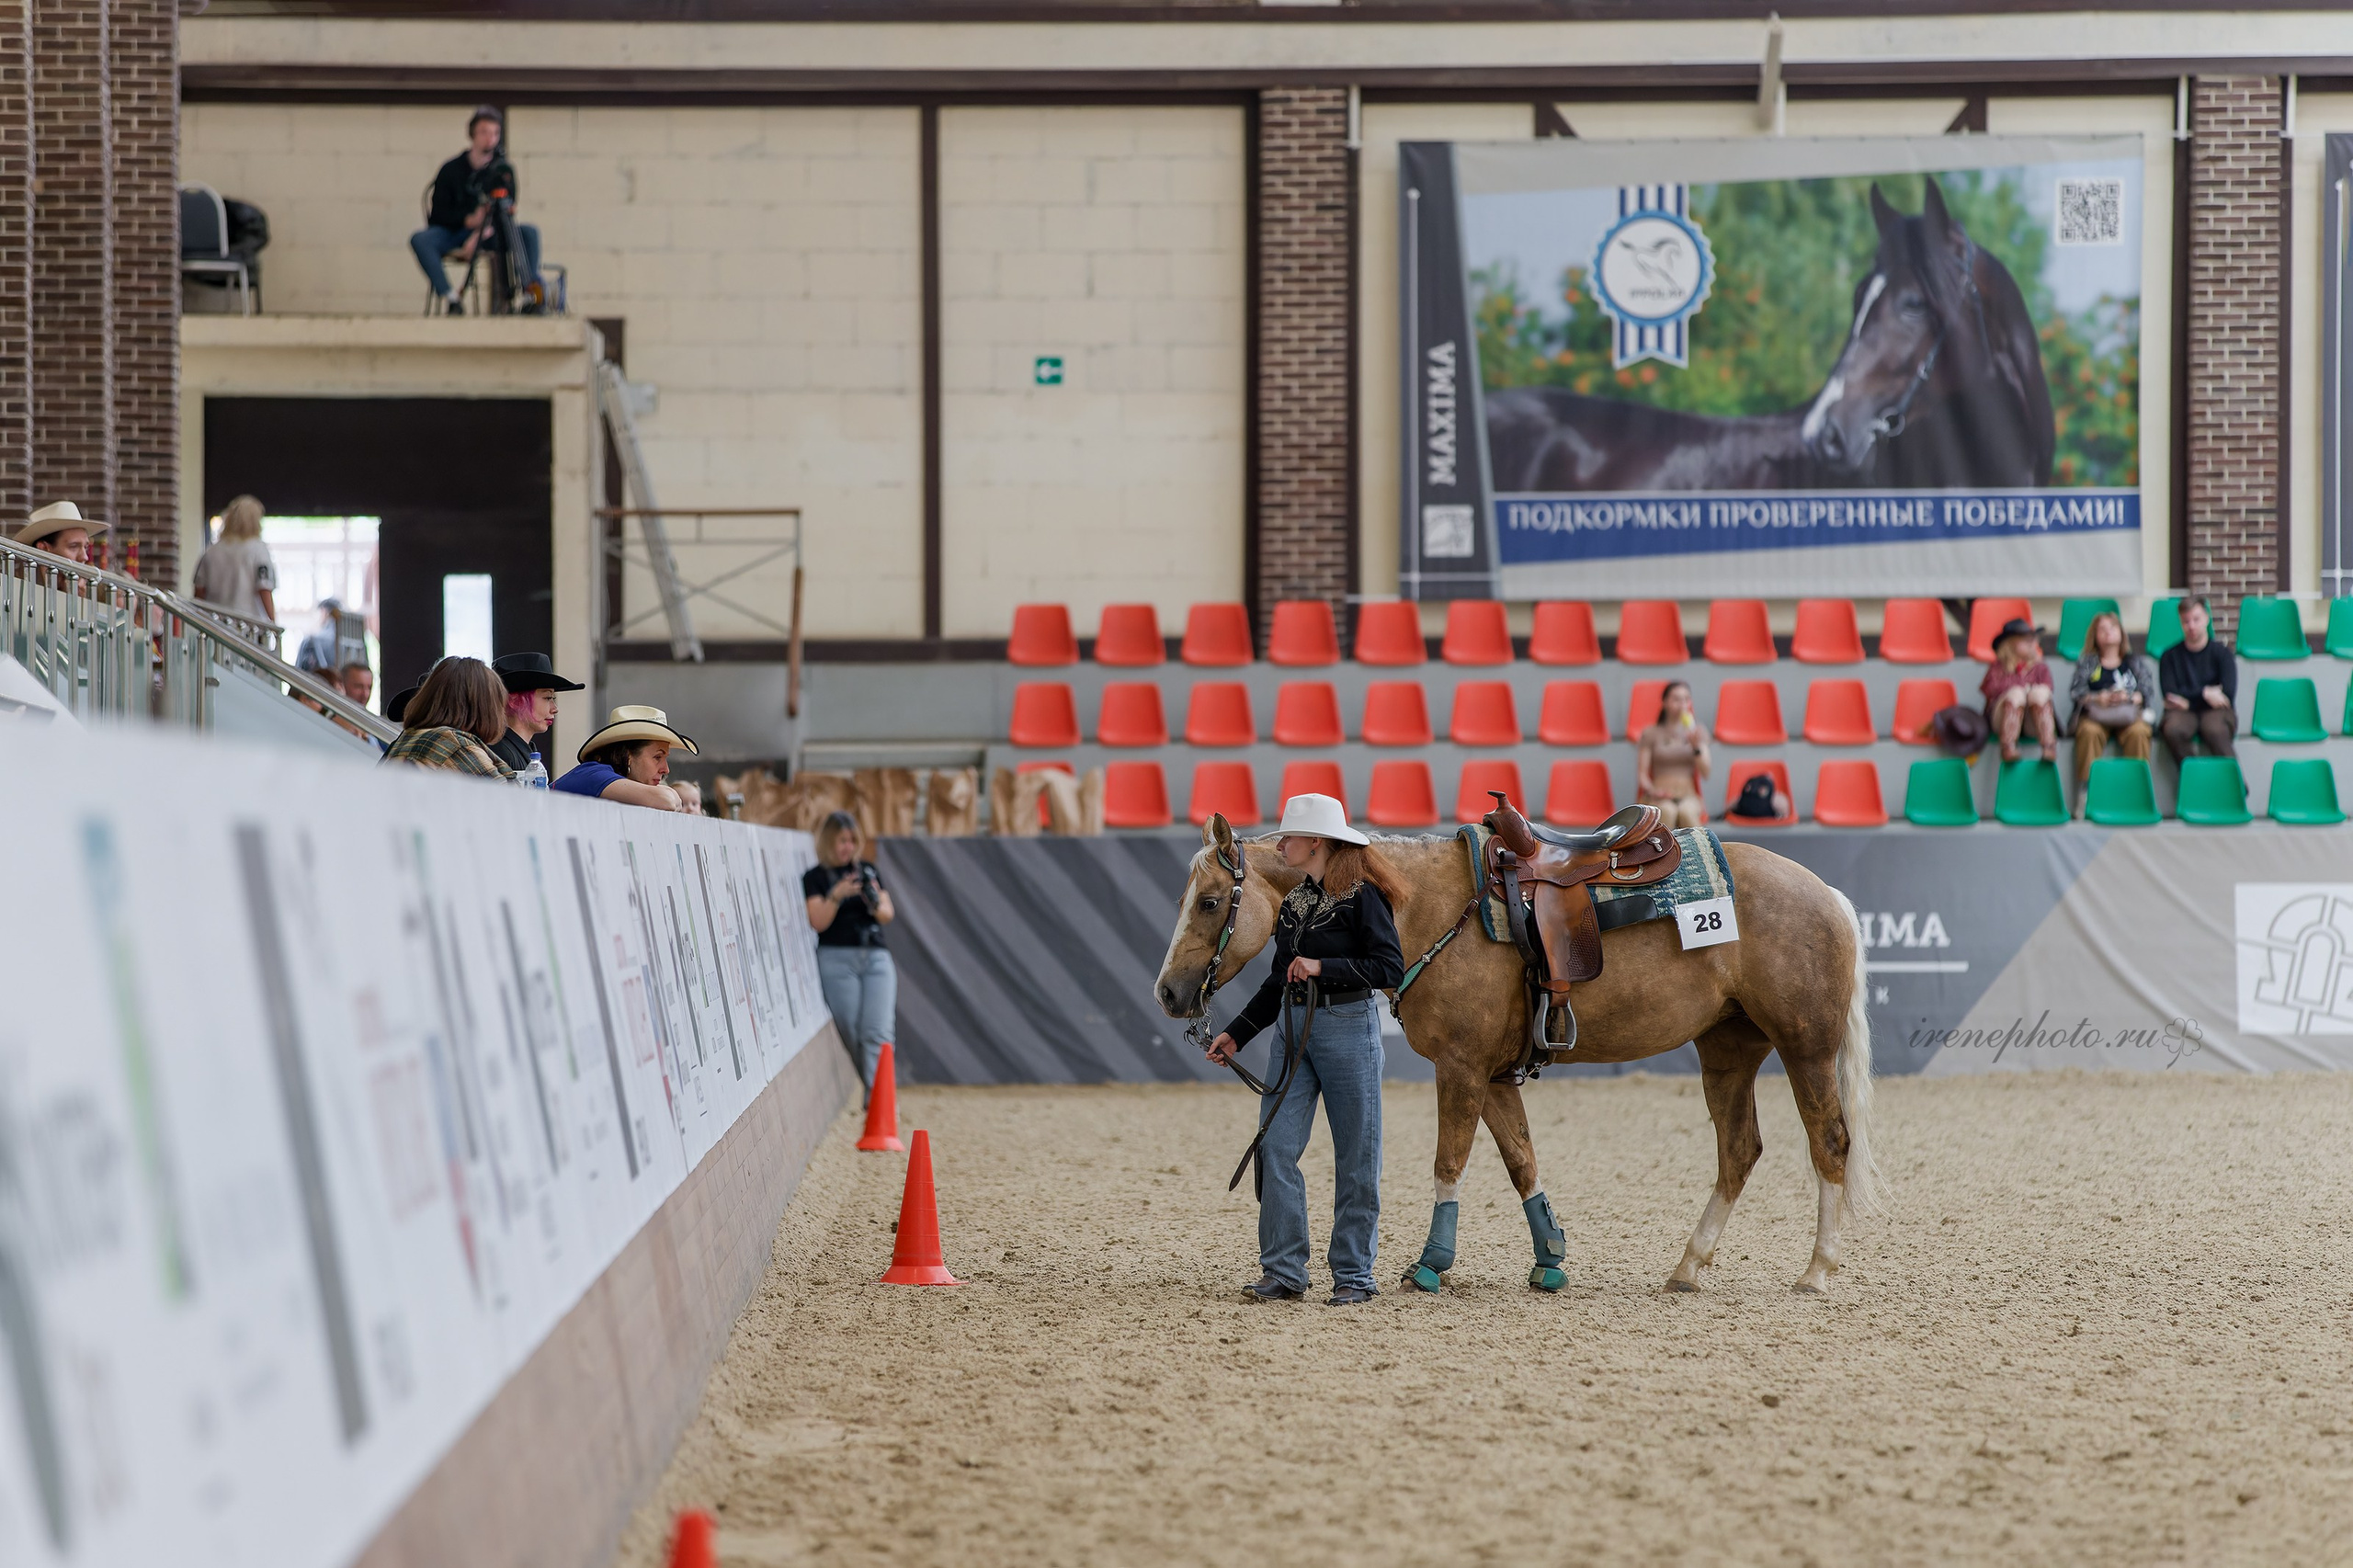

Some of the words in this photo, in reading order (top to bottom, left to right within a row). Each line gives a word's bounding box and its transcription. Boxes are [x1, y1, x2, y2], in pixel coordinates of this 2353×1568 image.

[1427, 340, 1456, 486] MAXIMA
[1508, 502, 1701, 534] ПОДКОРМКИ
[1709, 498, 1935, 529] ПРОВЕРЕННЫЕ
[1943, 496, 2125, 530] ПОБЕДАМИ!
[1693, 911, 1722, 933] 28
[1859, 911, 1951, 949] IMA
